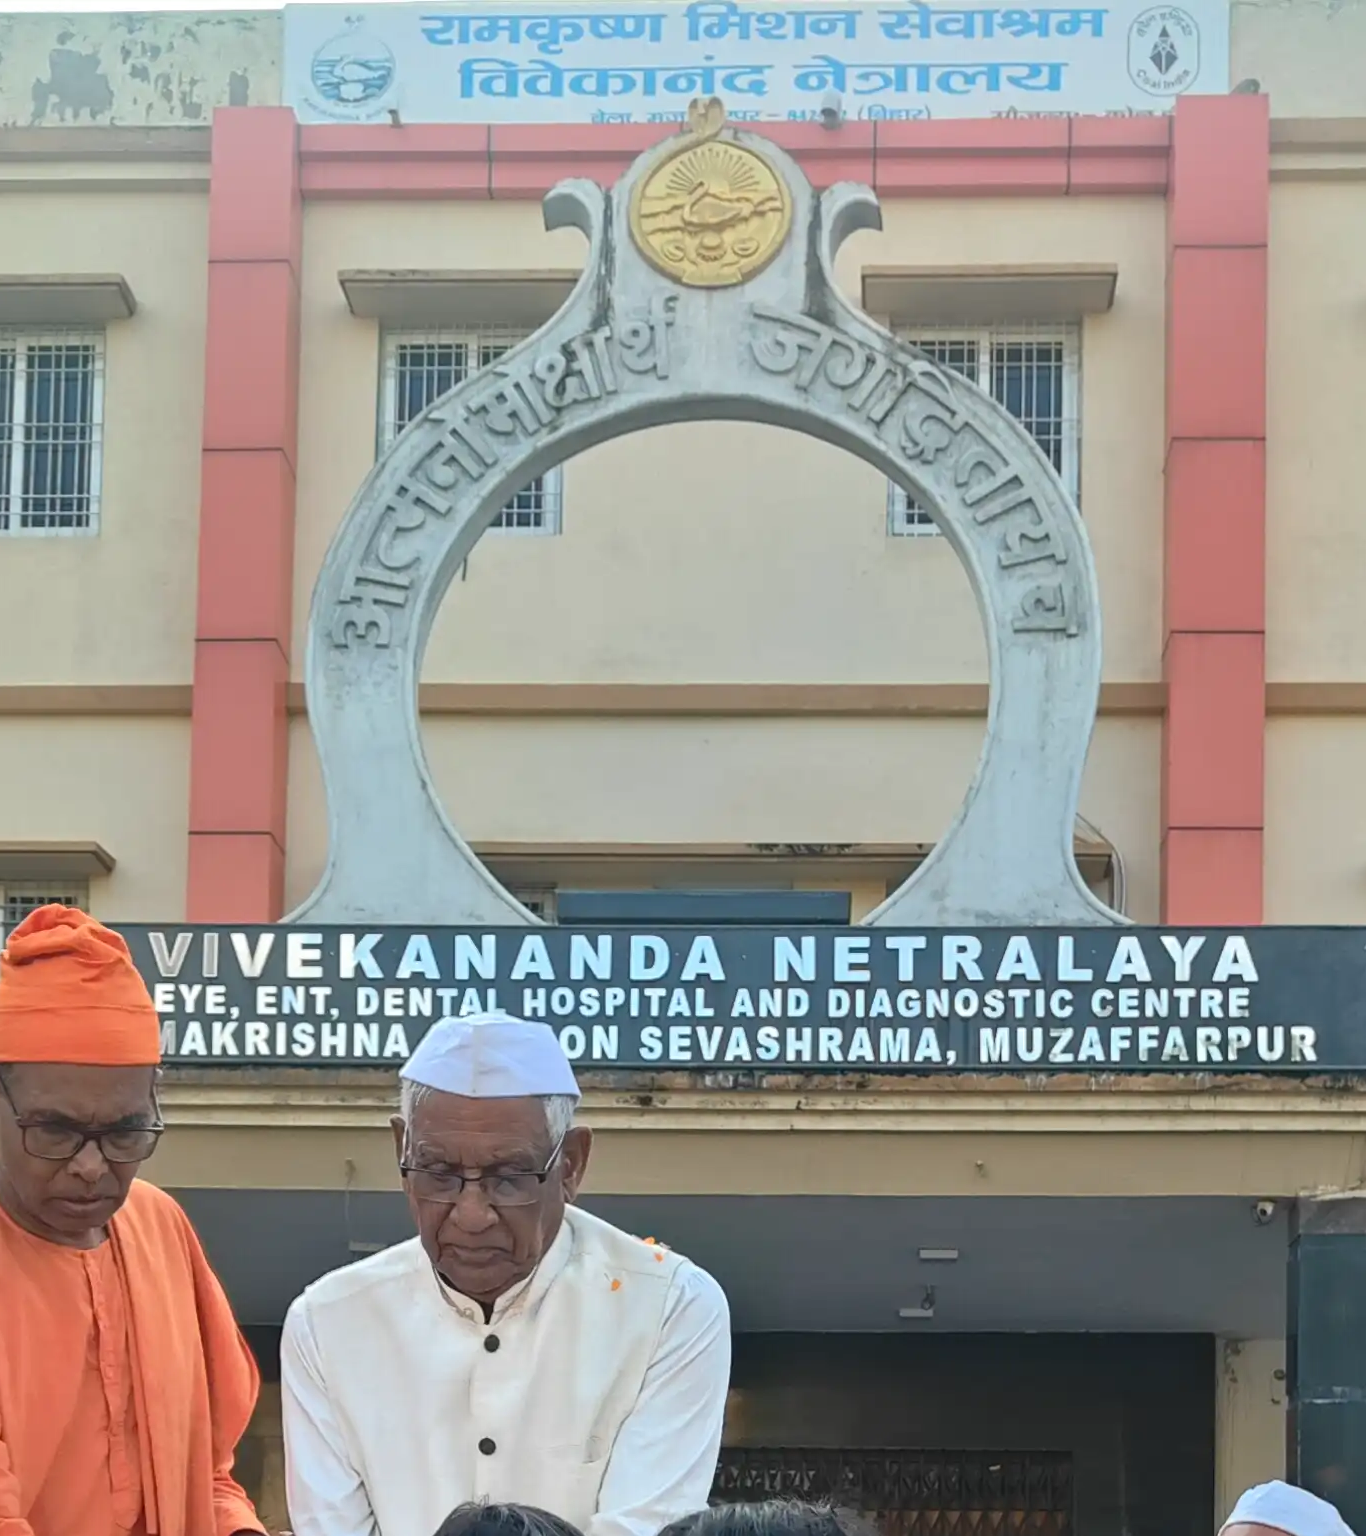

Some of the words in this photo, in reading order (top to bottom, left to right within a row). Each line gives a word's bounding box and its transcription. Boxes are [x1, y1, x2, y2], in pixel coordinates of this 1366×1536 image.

[420, 13, 666, 53] रामकृष्ण
[684, 1, 861, 41] मिशन
[878, 1, 1107, 40] सेवाश्रम
[458, 56, 774, 99] विवेकानंद
[793, 55, 1068, 96] नेत्रालय
[148, 932, 727, 981] VIVEKANANDA
[773, 935, 1259, 983] NETRALAYA
[157, 983, 240, 1019] EYE,
[257, 985, 341, 1019] ENT,
[356, 986, 505, 1018] DENTAL
[523, 987, 717, 1018] HOSPITAL
[732, 988, 811, 1018] AND
[827, 988, 1074, 1018] DIAGNOSTIC
[1090, 988, 1250, 1018] CENTRE
[638, 1026, 958, 1066] SEVASHRAMA,
[979, 1026, 1317, 1063] MUZAFFARPUR
